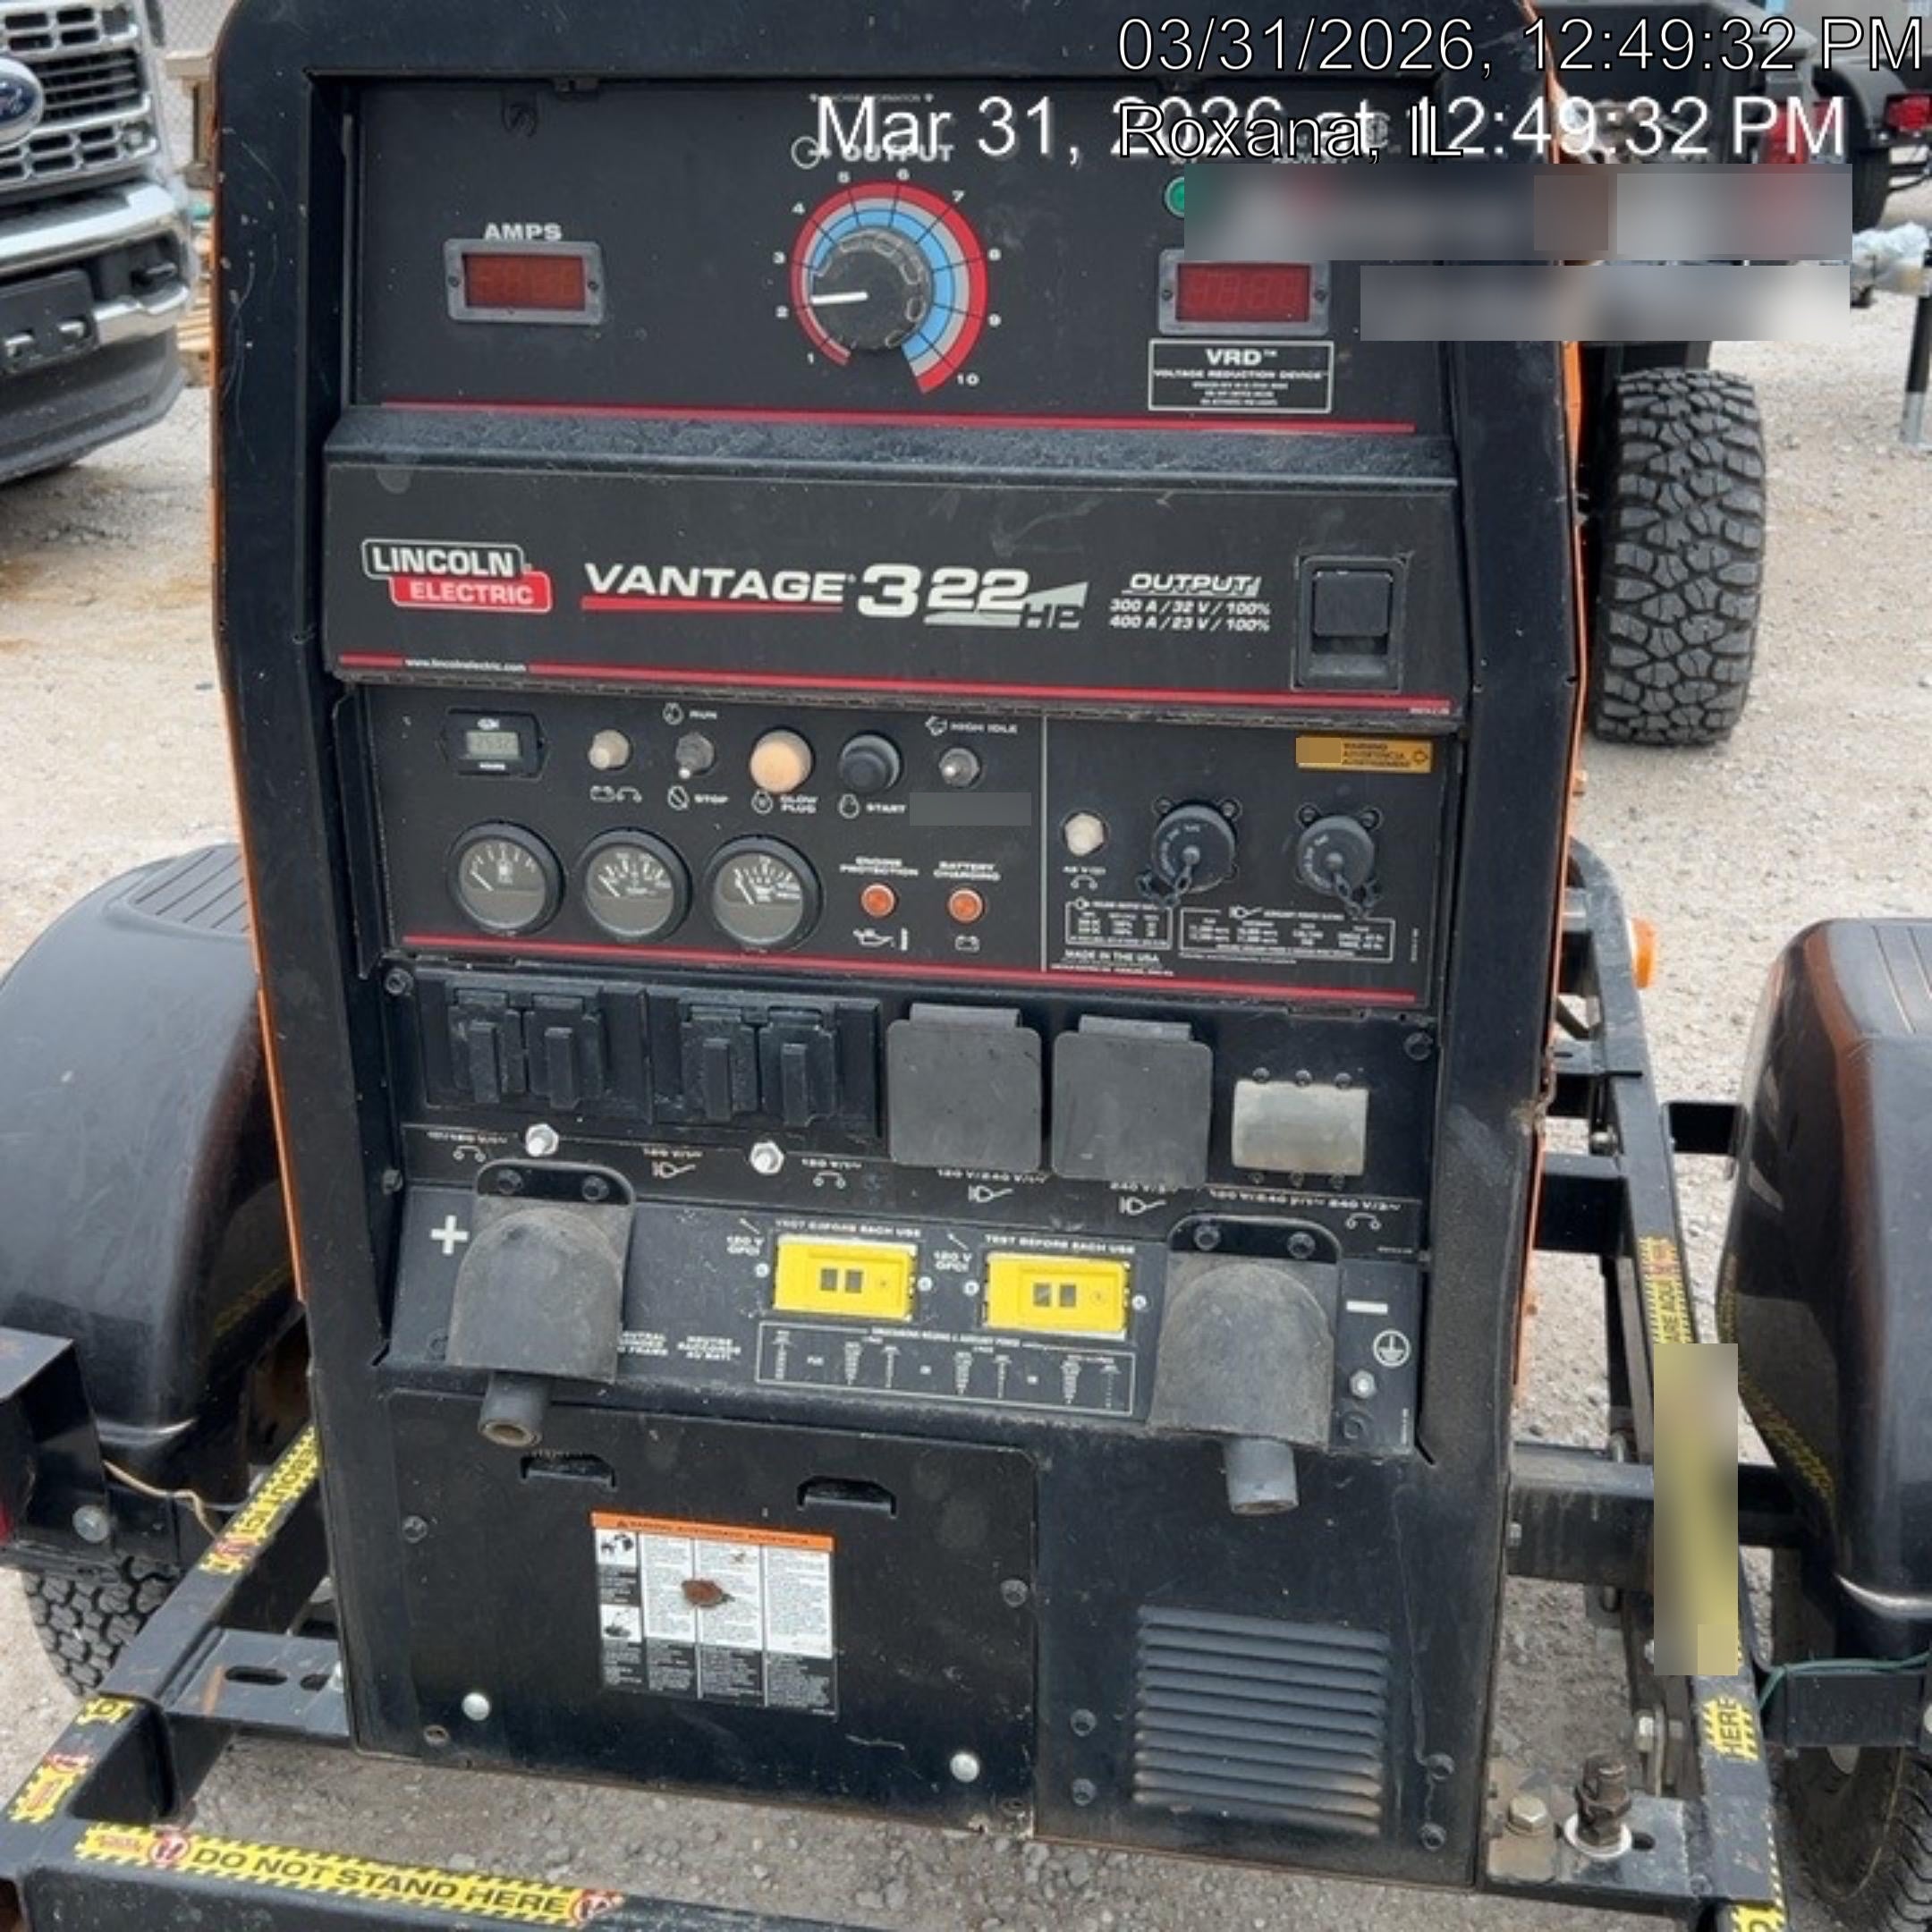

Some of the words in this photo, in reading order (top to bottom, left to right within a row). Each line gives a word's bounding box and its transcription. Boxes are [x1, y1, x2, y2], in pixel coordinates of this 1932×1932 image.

[838, 172, 850, 183] 5
[897, 169, 910, 181] 6
[953, 190, 965, 202] 7
[792, 202, 805, 214] 4
[483, 223, 563, 241] AMPS
[773, 251, 785, 264] 3
[775, 306, 789, 318] 2
[987, 314, 1001, 326] 9
[957, 373, 979, 386] 10
[371, 545, 514, 578] LINCOLN
[1129, 572, 1255, 592] OUTPUT
[409, 580, 535, 606] ELECTRIC
[1108, 598, 1143, 612] 300
[1225, 602, 1271, 615] 100%
[1108, 614, 1143, 628] 400
[1225, 618, 1271, 631] 100%
[405, 657, 527, 673] www.lincolnelectric.com
[984, 1233, 1015, 1244] TEST
[1018, 1237, 1070, 1249] BEFORE
[1072, 1241, 1105, 1251] EACH
[1717, 1696, 1742, 1759] HERE
[192, 1847, 236, 1868] DO
[253, 1855, 323, 1881] NOT
[335, 1868, 460, 1898] STAND
[465, 1884, 568, 1915] HERE
